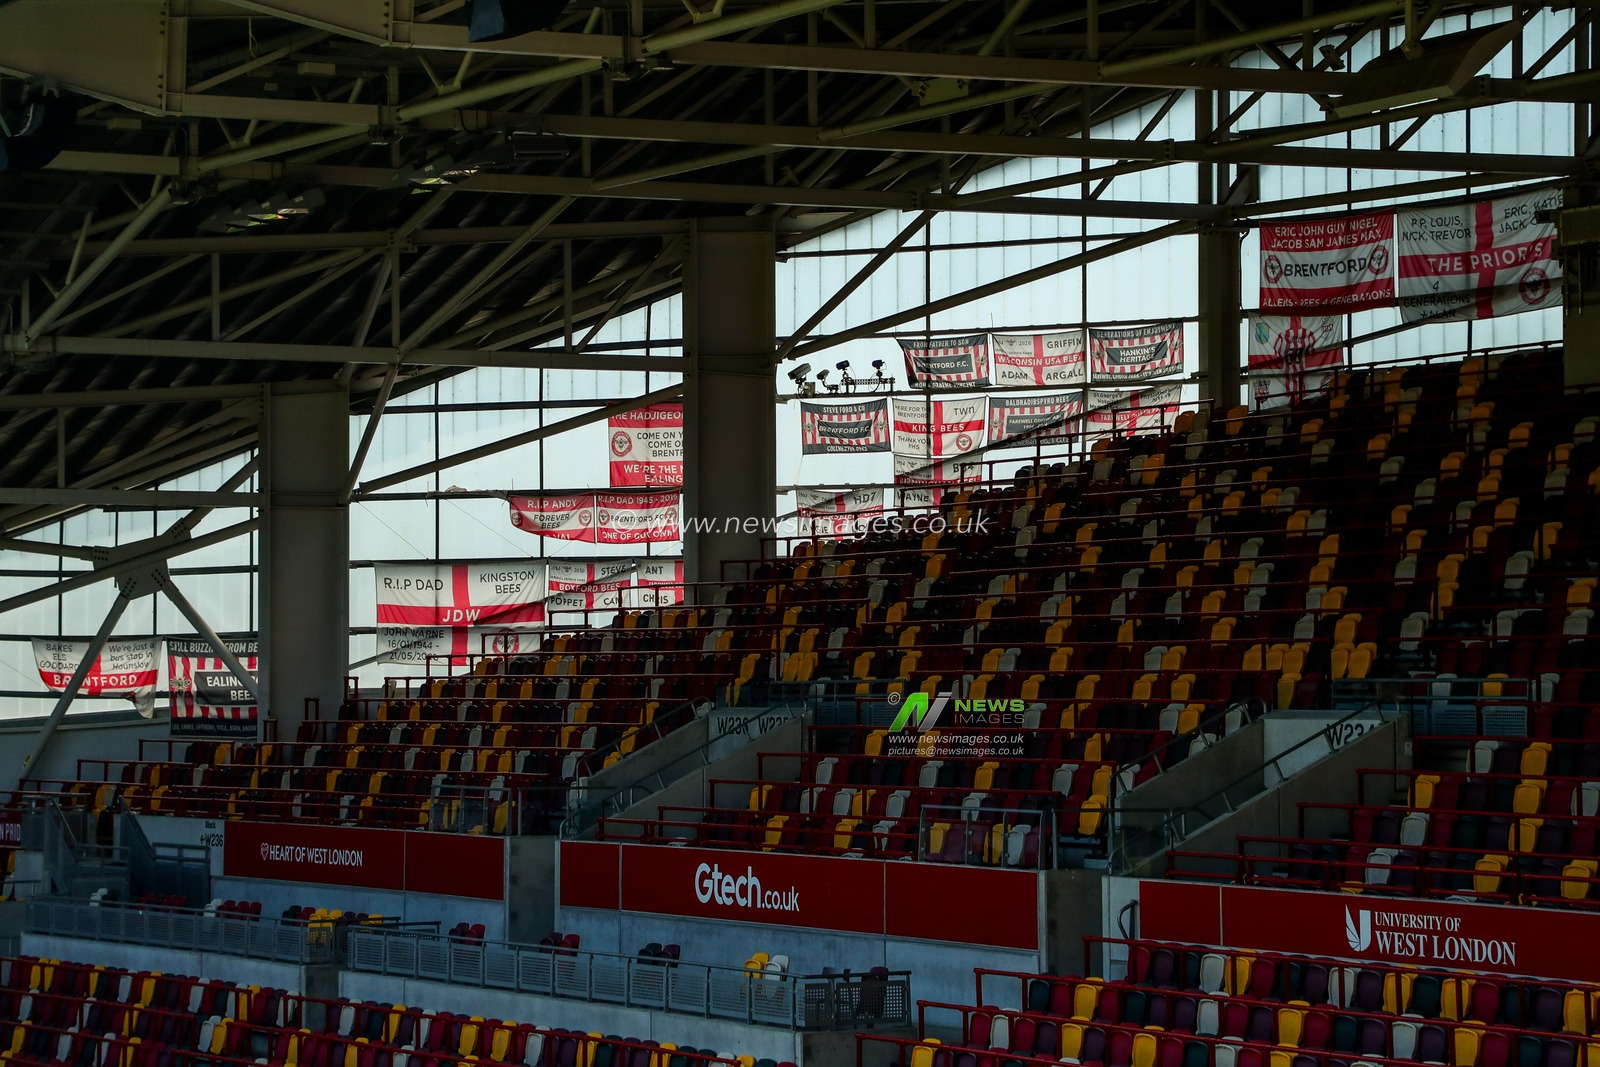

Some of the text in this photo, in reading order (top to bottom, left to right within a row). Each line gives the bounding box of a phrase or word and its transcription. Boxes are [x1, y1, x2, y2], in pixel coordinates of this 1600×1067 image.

[1430, 215, 1463, 228] LOUIS,
[1275, 217, 1378, 238] ERIC JOHN GUY NIGEL
[1271, 229, 1382, 250] JACOB SAM JAMES MAX
[1430, 228, 1472, 241] TREVOR
[1427, 241, 1544, 273] THE PRIOR'S
[1284, 258, 1367, 277] BRENTFORD
[1432, 280, 1440, 292] 4
[1403, 293, 1471, 308] GENERATIONS
[1046, 337, 1082, 349] GRIFFIN
[1119, 346, 1156, 357] HANKIN'S
[997, 355, 1043, 367] WSCONSIN
[1045, 358, 1061, 366] USA
[1119, 353, 1154, 363] HERITAG
[1001, 370, 1028, 381] ADAM
[1045, 368, 1084, 381] ARGALL
[612, 411, 684, 420] HE HADJIGEO
[940, 423, 965, 433] BEES
[637, 432, 660, 440] COME
[663, 431, 676, 439] ON
[648, 440, 672, 448] COME
[652, 449, 684, 457] BRENTF
[623, 464, 656, 474] WE'RE
[658, 464, 677, 474] THE
[552, 498, 577, 508] ANDY
[616, 496, 634, 504] DAD
[636, 496, 653, 504] 1945
[853, 492, 876, 505] HD7
[533, 513, 570, 522] FOREVER
[541, 521, 561, 529] BEES
[601, 531, 618, 539] ONE
[620, 532, 631, 540] OF
[652, 529, 673, 538] OWN
[601, 564, 626, 576] STEVE
[645, 566, 664, 575] ANT
[480, 570, 535, 583] KINGSTON
[384, 578, 444, 591] R.I.P DAD
[495, 583, 521, 594] BEES
[559, 582, 621, 593] BOXFORD BEES
[551, 596, 584, 607] POPPET
[643, 594, 669, 604] CHIS
[442, 608, 481, 623] JDW
[384, 628, 445, 639] JOHN WARNE
[46, 643, 73, 653] BAKES
[190, 642, 214, 653] BUZZ
[110, 653, 124, 662] bus
[126, 653, 144, 662] stop
[53, 674, 138, 687] BRNTFORD
[1327, 724, 1374, 745] W23
[205, 833, 224, 847] W236
[269, 844, 363, 867] HEART OF WEST LONDON
[695, 862, 800, 912] Gtech.co.uk
[1374, 911, 1462, 932] UNIVERSITY OF
[1375, 930, 1516, 967] WEST LONDON
